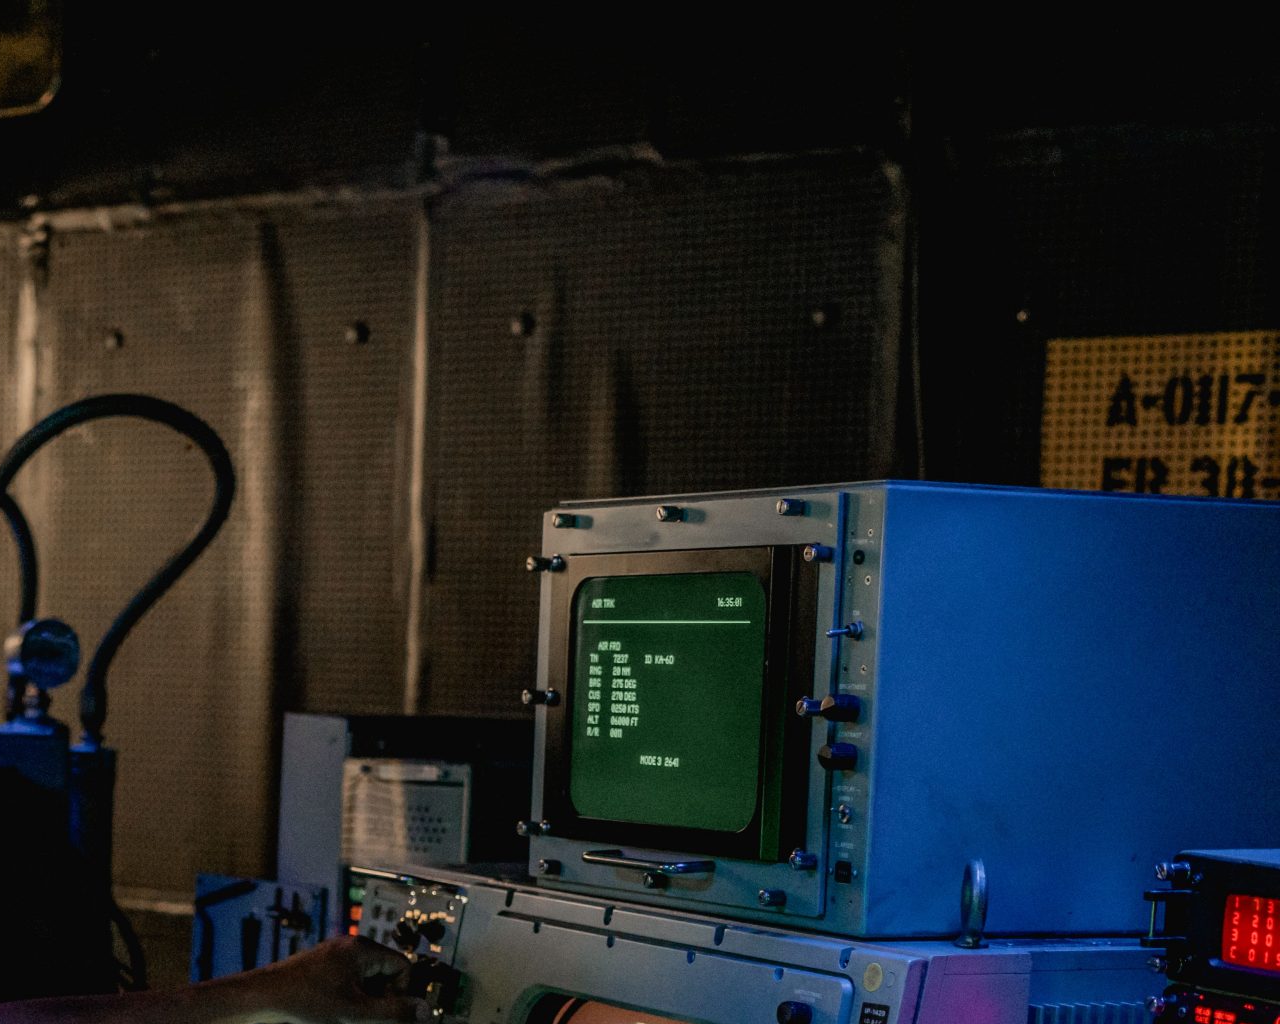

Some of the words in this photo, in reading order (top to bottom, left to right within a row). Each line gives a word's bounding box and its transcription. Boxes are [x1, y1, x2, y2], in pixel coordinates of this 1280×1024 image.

[592, 598, 602, 608] AIR
[603, 598, 615, 608] TRK
[717, 597, 743, 607] 16:35:01
[598, 641, 608, 651] AIR
[645, 654, 652, 664] ID
[589, 666, 602, 676] RNG
[588, 678, 601, 688] BRG
[625, 679, 637, 689] DEG
[624, 692, 637, 701] DEG
[587, 702, 601, 712] SPD
[627, 704, 640, 714] KTS
[587, 715, 599, 724] ALT
[630, 717, 639, 727] FT
[640, 755, 657, 766] MODE
[1235, 896, 1240, 908] 1
[1232, 912, 1240, 925] 2
[1231, 929, 1239, 941] 3
[1230, 946, 1237, 959] C
